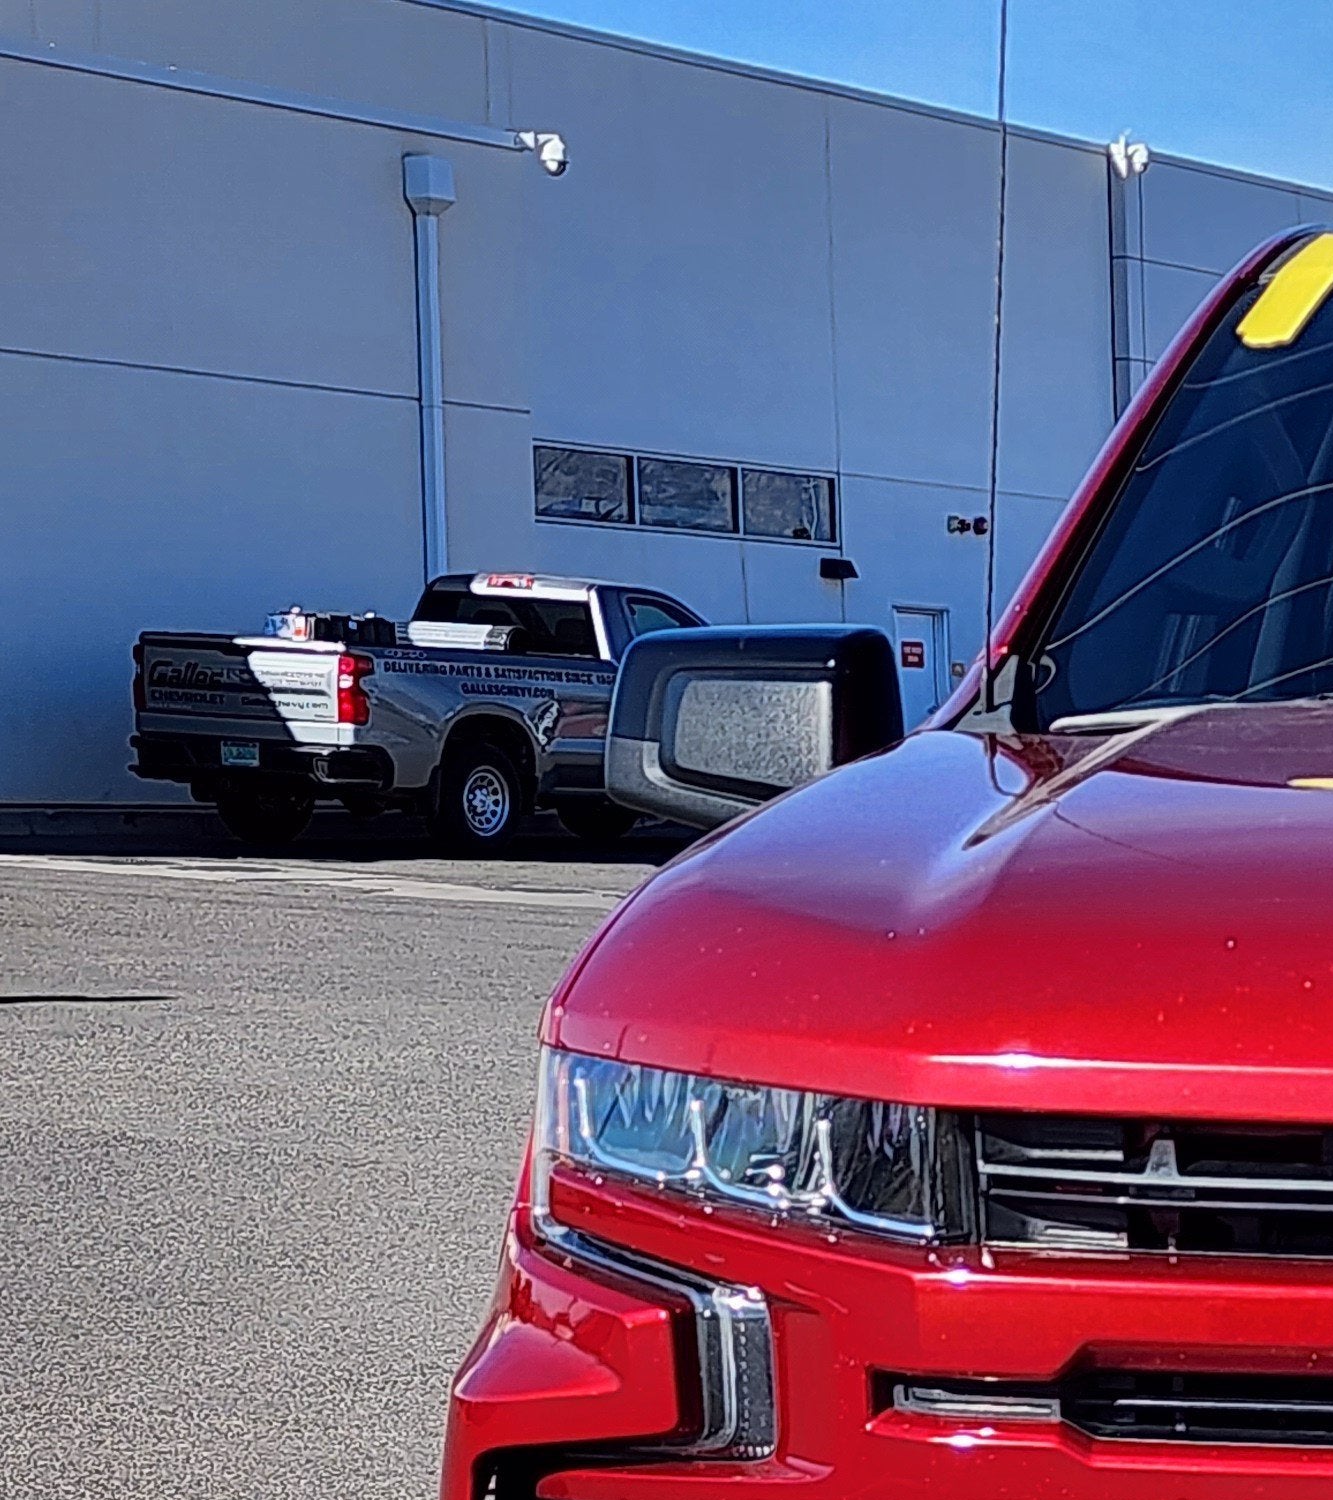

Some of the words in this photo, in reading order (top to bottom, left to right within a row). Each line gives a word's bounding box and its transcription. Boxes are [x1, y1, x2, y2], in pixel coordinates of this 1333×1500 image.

[384, 661, 448, 675] DELIVERING
[449, 664, 482, 678] PARTS
[485, 667, 492, 678] &
[494, 667, 563, 682] SATISFACTION
[151, 689, 225, 704] CHEVROLET
